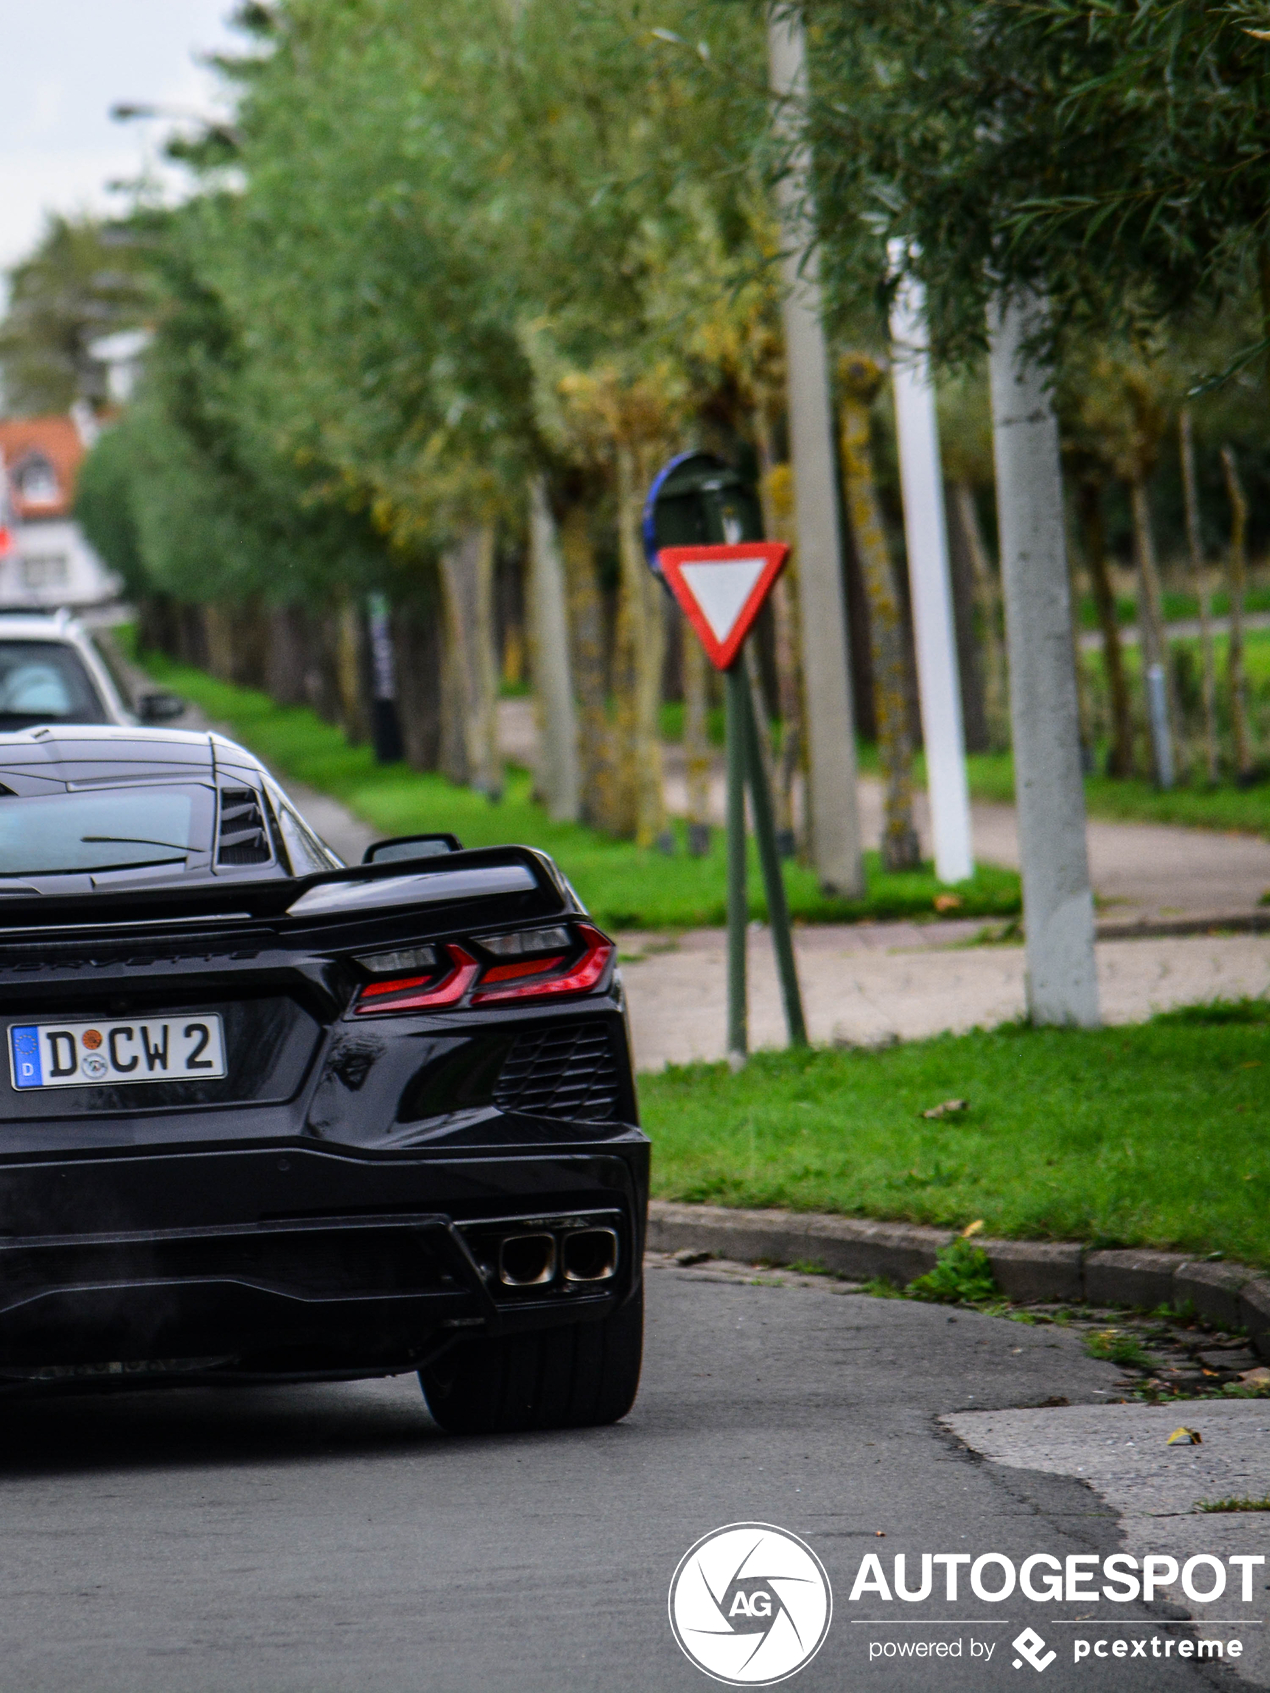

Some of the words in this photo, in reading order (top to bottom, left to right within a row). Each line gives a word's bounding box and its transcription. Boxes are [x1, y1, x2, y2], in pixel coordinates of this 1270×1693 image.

[46, 1030, 78, 1078] D
[108, 1024, 169, 1073] CW
[183, 1023, 214, 1070] 2
[21, 1063, 35, 1077] D
